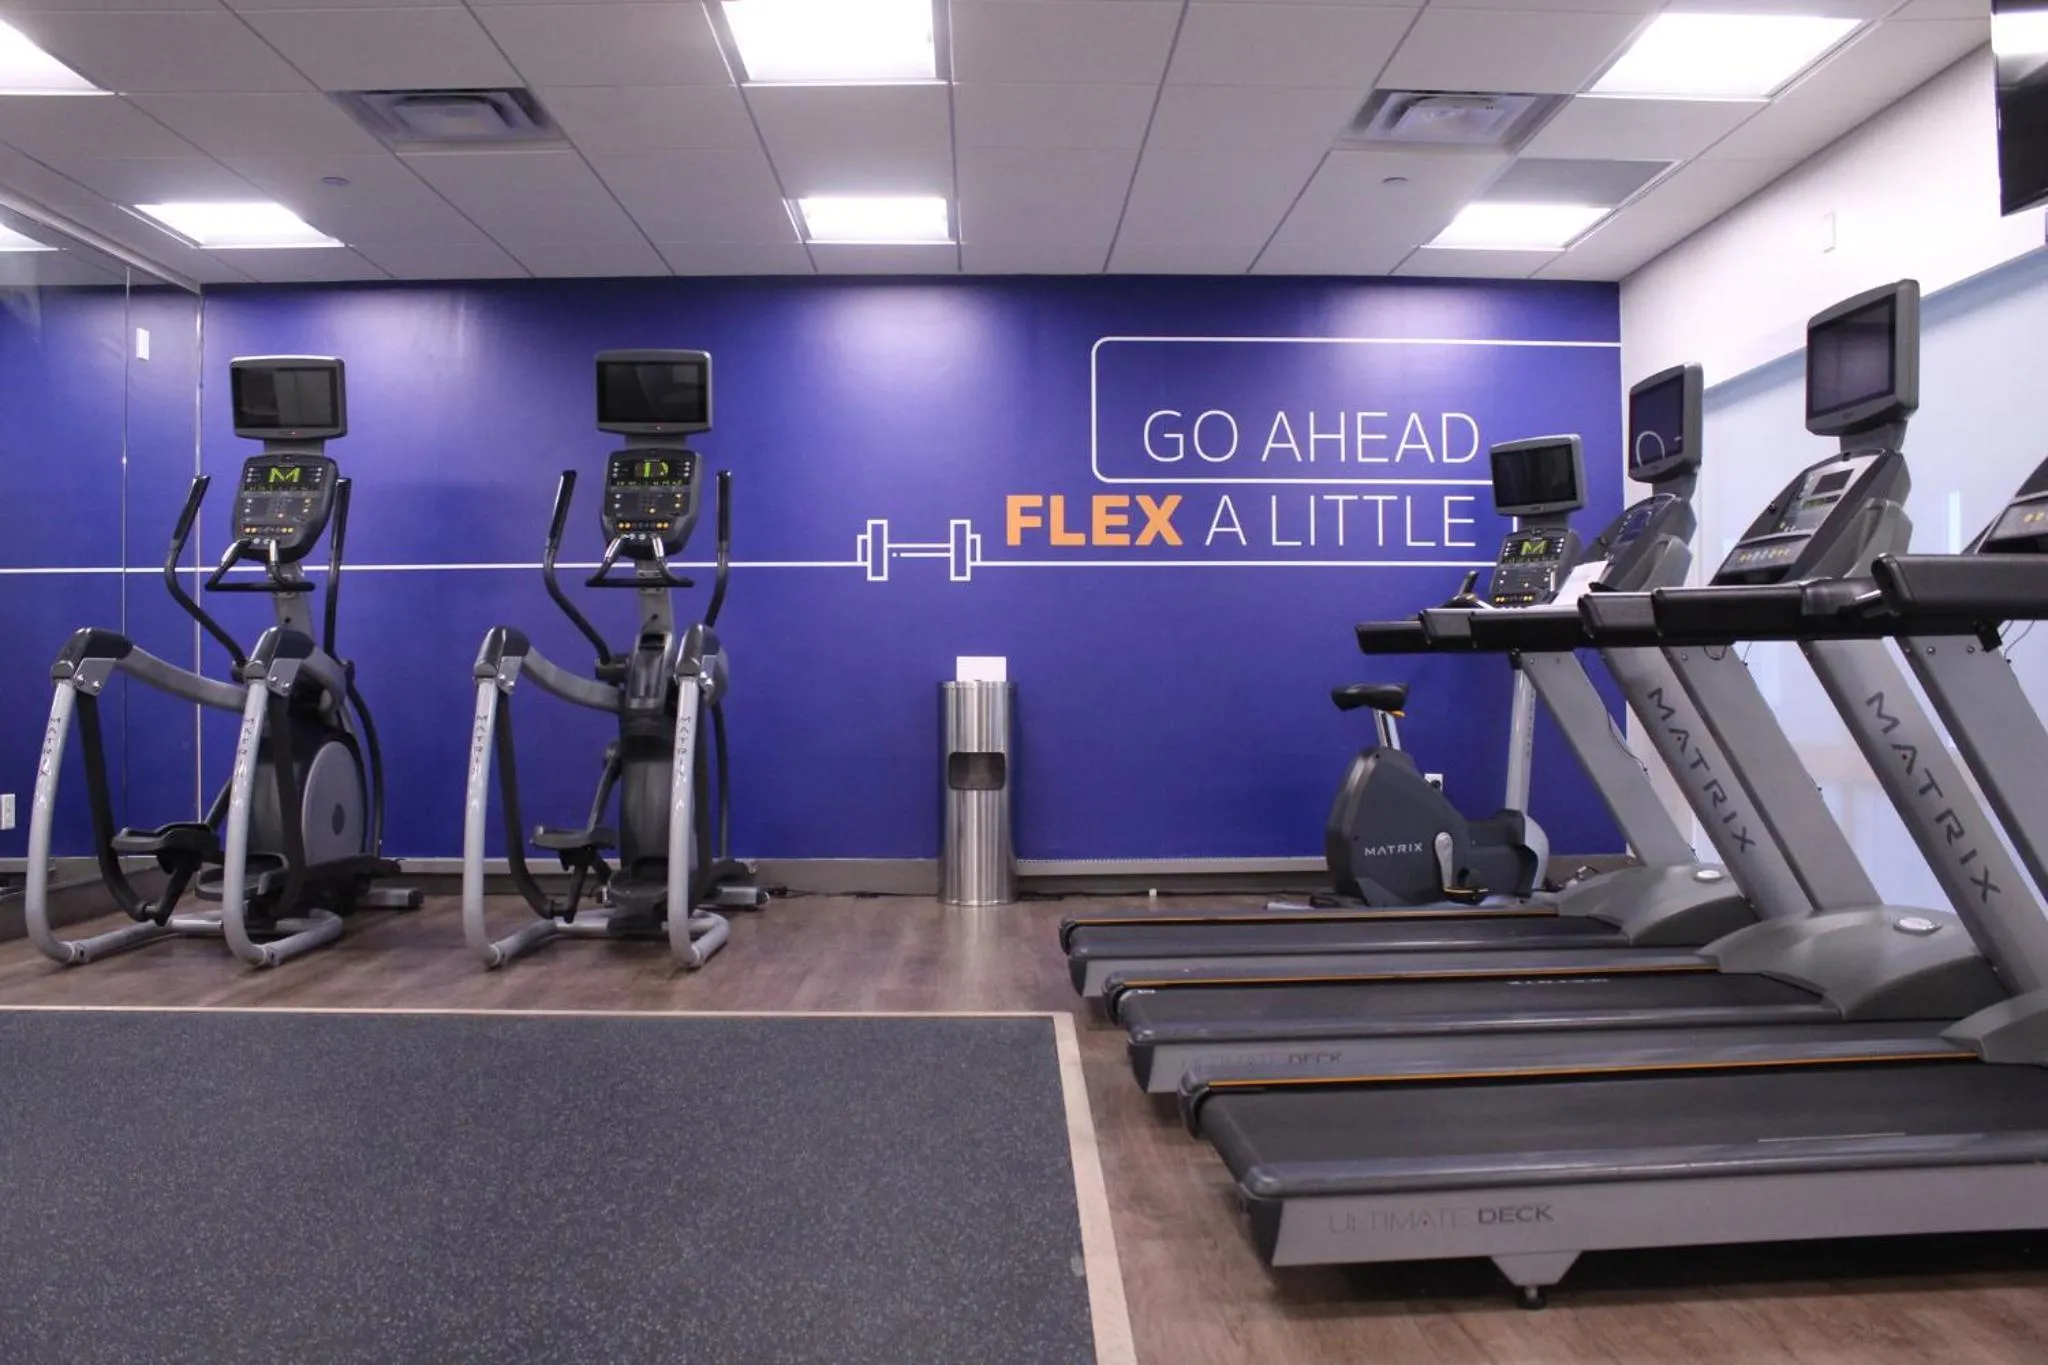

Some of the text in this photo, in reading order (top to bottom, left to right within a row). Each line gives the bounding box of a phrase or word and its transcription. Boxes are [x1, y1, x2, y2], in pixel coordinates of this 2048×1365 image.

[1143, 409, 1479, 464] GO AHEAD
[1006, 494, 1476, 547] FLEX A LITTLE
[1647, 687, 1757, 854] MATRIX
[1864, 690, 2002, 905] MATRIX
[1364, 842, 1423, 857] MATRIX
[1478, 1204, 1554, 1224] DECK
